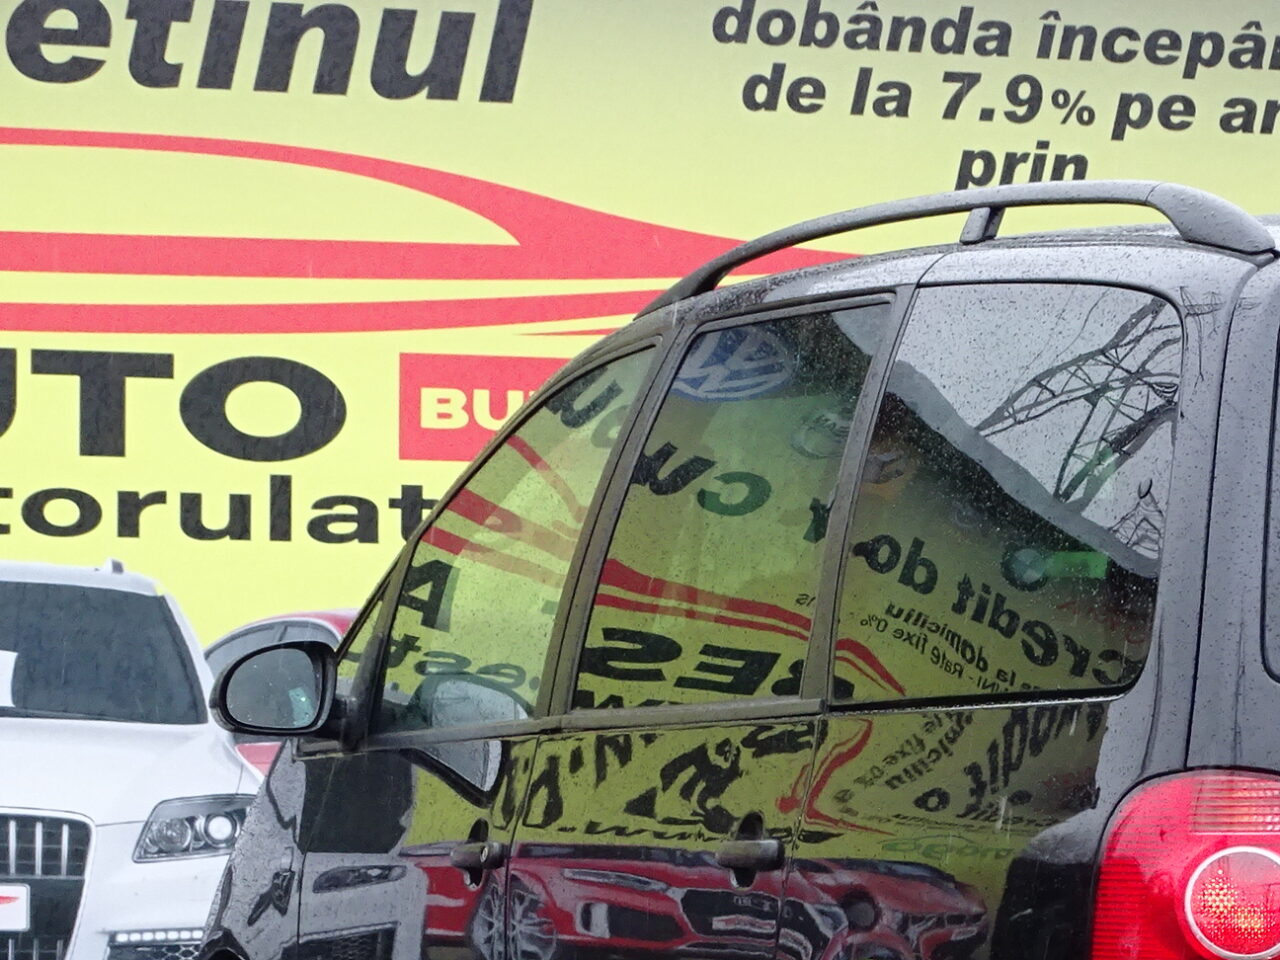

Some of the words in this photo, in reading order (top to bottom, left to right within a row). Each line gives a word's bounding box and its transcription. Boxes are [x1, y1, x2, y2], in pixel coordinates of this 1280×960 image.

[712, 0, 1013, 57] dobânda
[742, 63, 826, 114] de
[850, 67, 912, 117] la
[1110, 89, 1197, 140] pe
[954, 140, 1088, 191] prin
[0, 348, 347, 462] TO
[420, 387, 540, 432] BU
